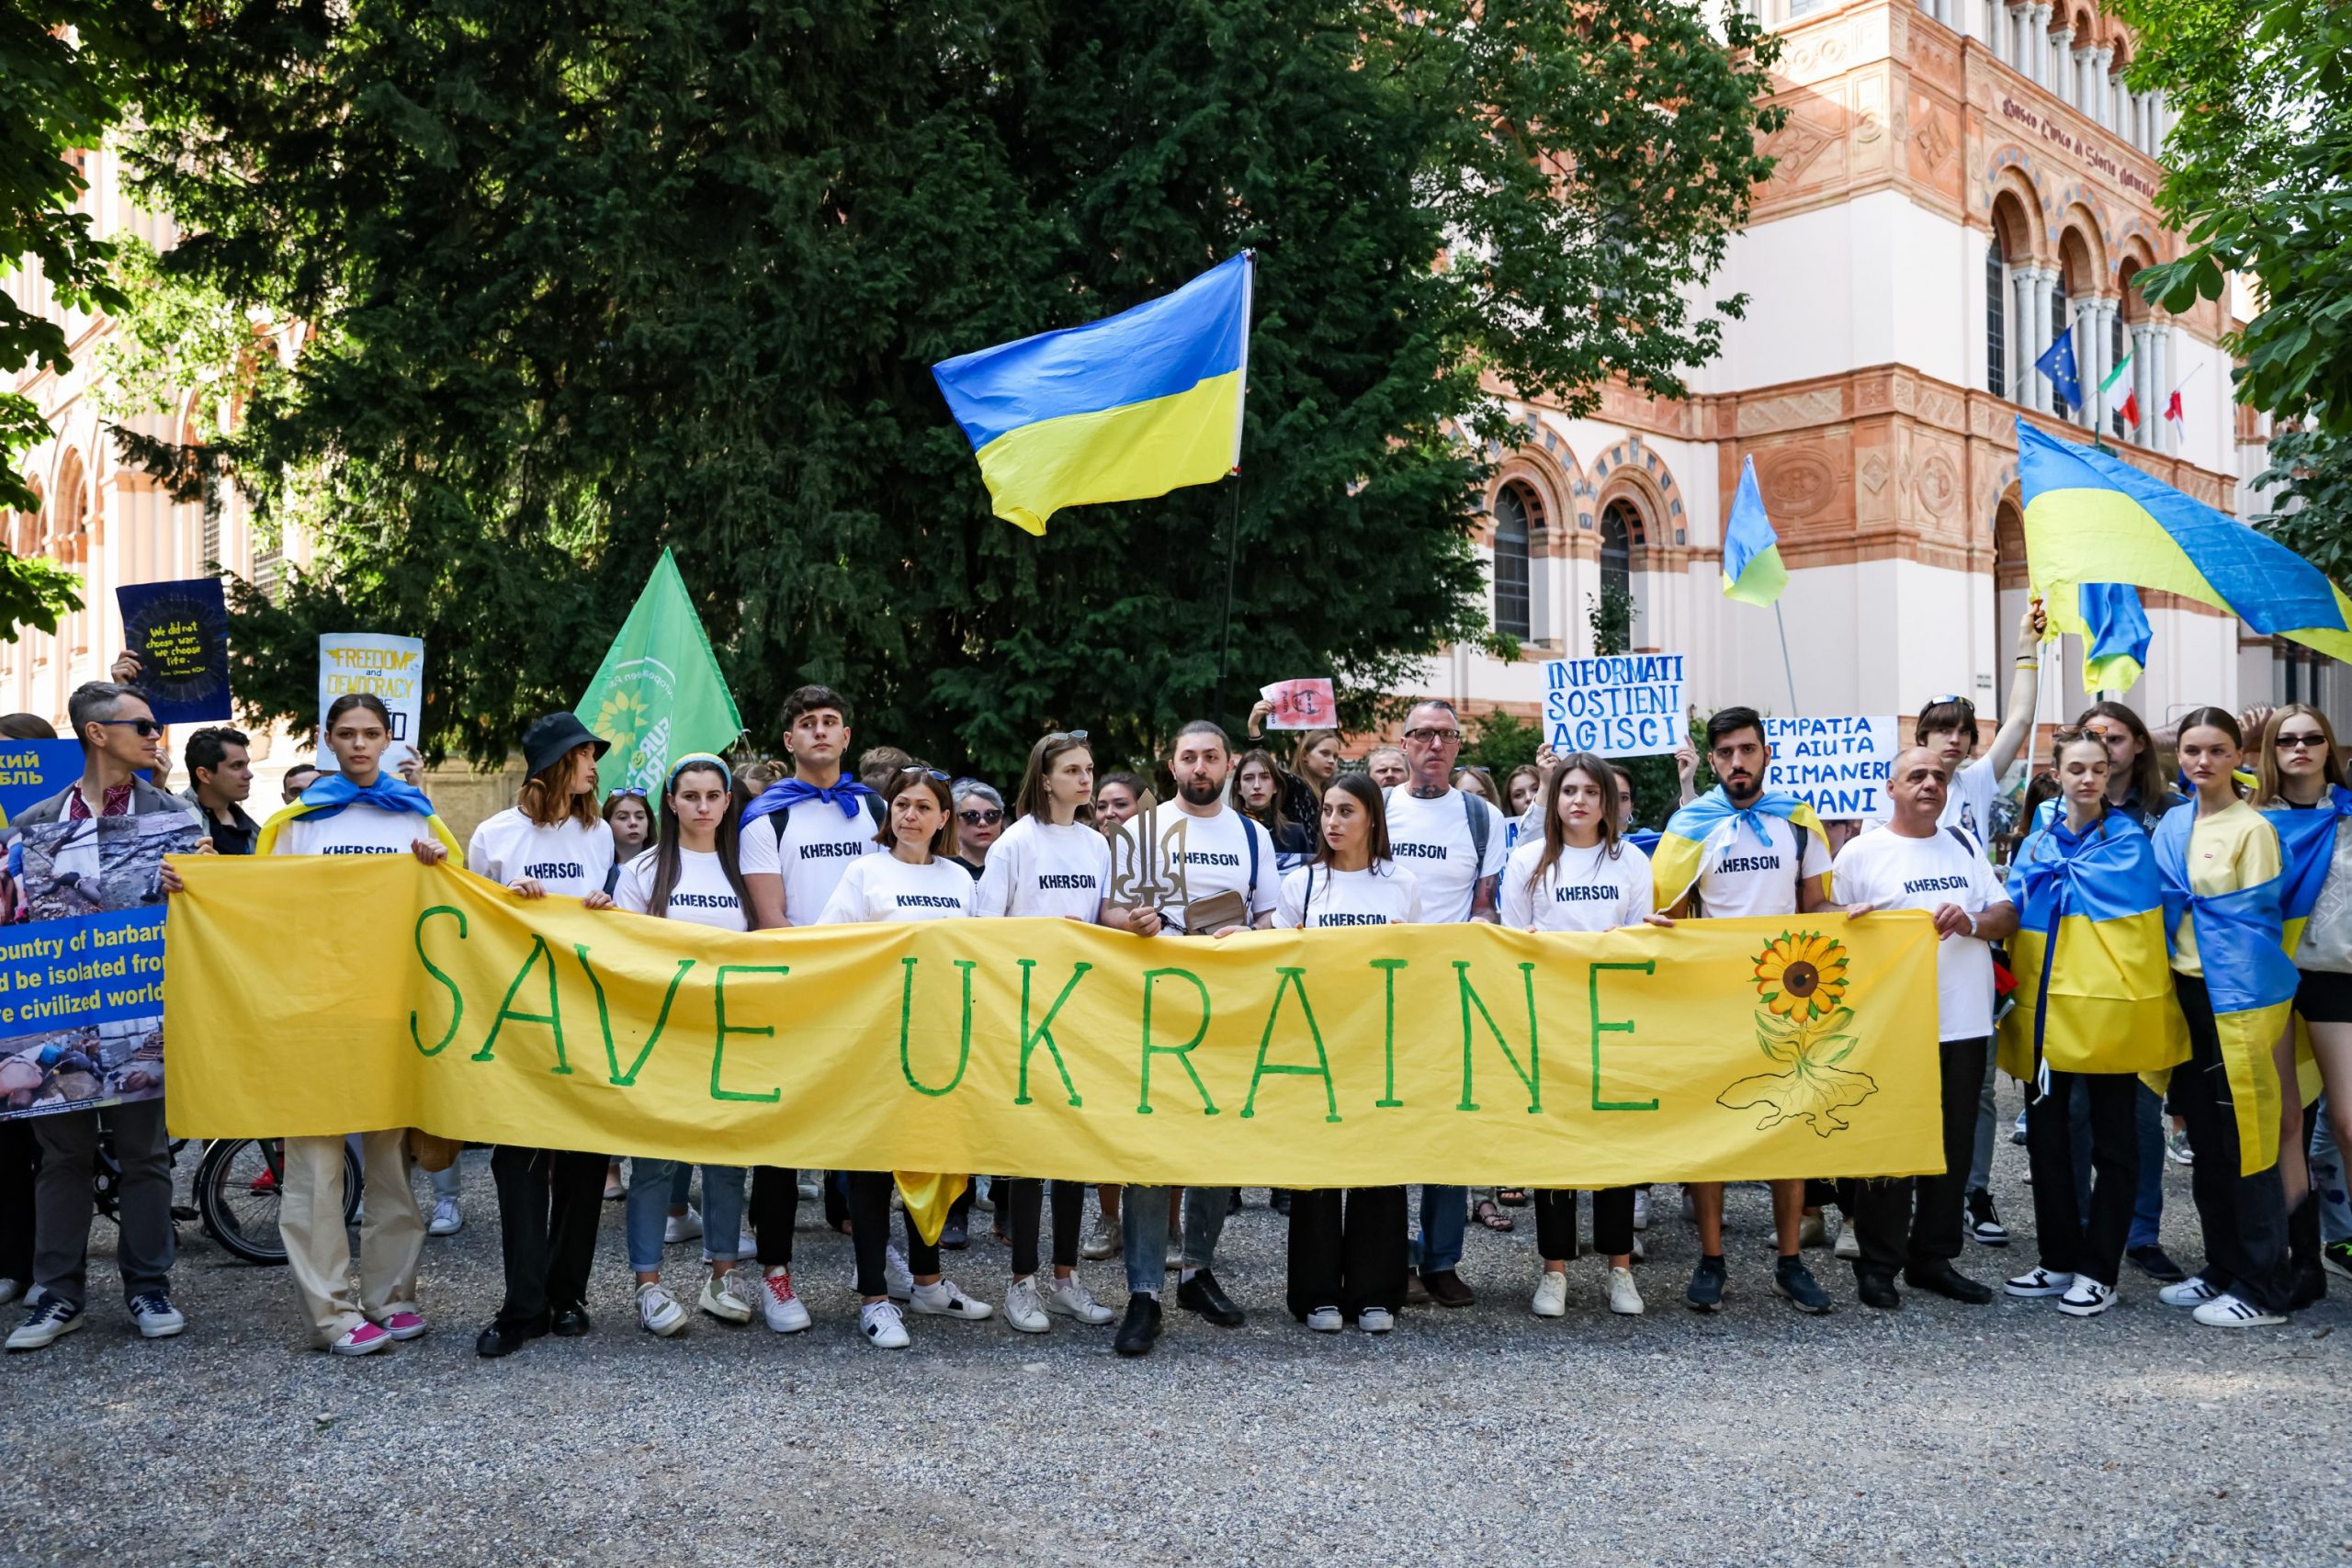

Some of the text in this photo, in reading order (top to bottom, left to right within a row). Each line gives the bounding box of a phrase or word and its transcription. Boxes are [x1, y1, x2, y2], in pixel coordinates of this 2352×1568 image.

[168, 621, 181, 635] did
[182, 621, 198, 632] not
[145, 638, 174, 649] choose
[171, 646, 201, 656] choose
[334, 648, 409, 671] FREEDOM
[366, 669, 382, 677] and
[1546, 655, 1684, 689] INFORMATI
[326, 674, 413, 698] DEMOCRACY
[1548, 684, 1679, 721] SOSTIENI
[1551, 716, 1678, 753] AGISCI
[1795, 736, 1874, 758] AIUTA
[1784, 787, 1877, 814] MANI
[800, 841, 862, 859] KHERSON
[1172, 852, 1240, 866] KHERSON
[1390, 842, 1447, 860] HERSON
[524, 863, 584, 879] KHERSON
[1039, 874, 1096, 890] KHERSON
[1905, 875, 1969, 895] KHERSON
[669, 894, 740, 908] KHERSON
[897, 895, 961, 909] KHERSON
[1555, 885, 1619, 903] KHERSON
[1318, 914, 1386, 927] KHERSON
[70, 930, 86, 952] of
[16, 971, 42, 990] be
[48, 955, 126, 986] isolated
[131, 953, 165, 974] fro
[20, 989, 101, 1021] civilized
[411, 905, 1659, 1122] SAVE UKRAINE
